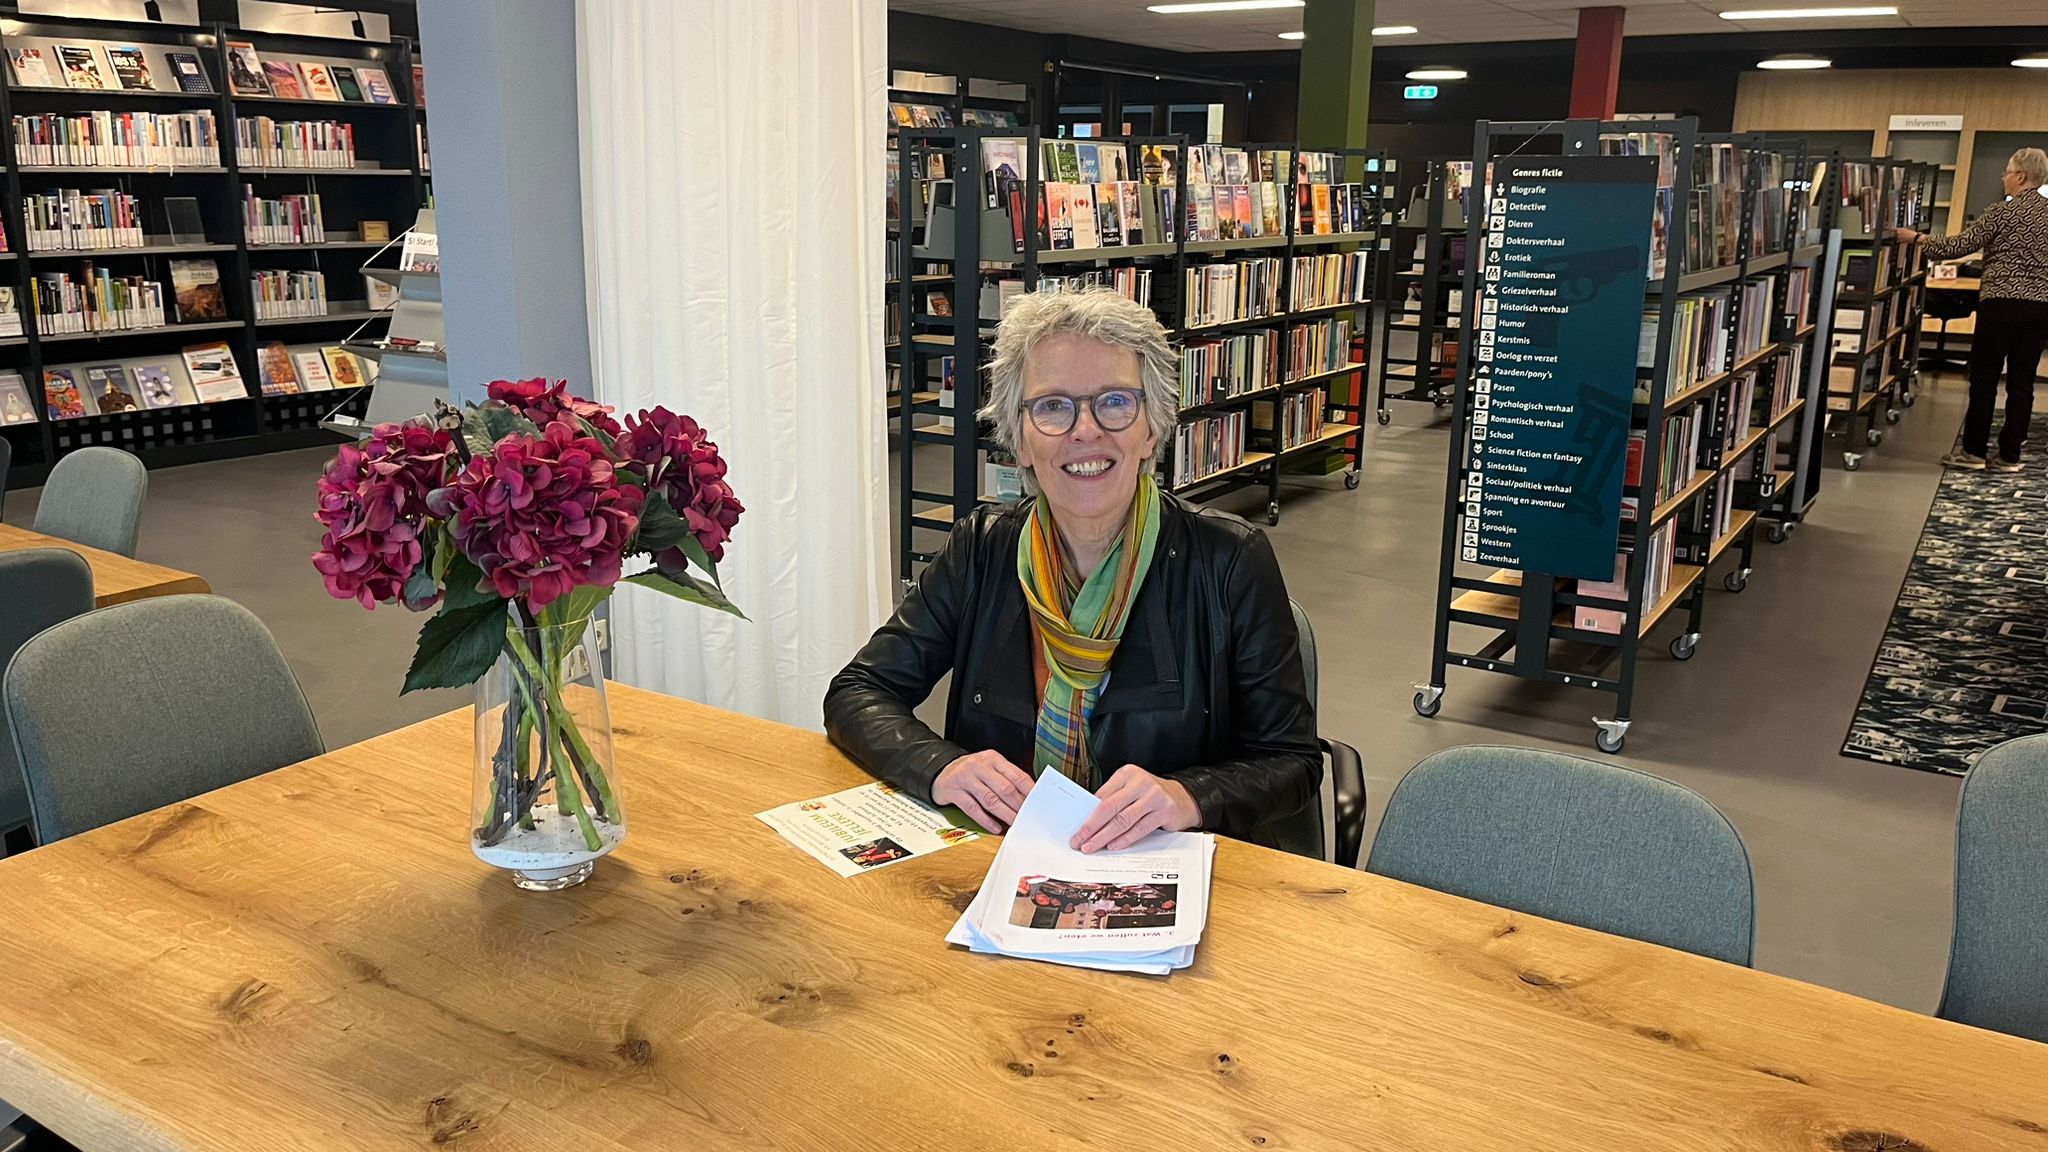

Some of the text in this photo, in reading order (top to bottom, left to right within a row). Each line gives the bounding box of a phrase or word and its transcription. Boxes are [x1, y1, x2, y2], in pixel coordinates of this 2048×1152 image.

[1511, 186, 1546, 196] Biografie
[1510, 202, 1546, 210] Detective
[1508, 220, 1533, 228] Dieren
[1506, 237, 1564, 246] Doktersverhaal
[1505, 254, 1532, 262] Erotiek
[1504, 270, 1556, 280] Familieroman
[1502, 287, 1556, 296] Griezelverhaal
[1500, 304, 1568, 314] Historisch verhaal
[1499, 320, 1526, 328] Humor
[1784, 316, 1796, 329] T
[1498, 336, 1530, 344] Kerstmis
[1496, 352, 1522, 362] Oorlog
[1494, 368, 1552, 380] Paarden/pony's
[1217, 378, 1226, 391] L
[1494, 384, 1514, 392] Pasen
[1492, 399, 1574, 412] Psychologisch verhaal
[1491, 415, 1564, 428] Romantisch verhaal
[1490, 430, 1514, 440] School
[1488, 446, 1582, 464] Science fiction en fantasy
[1486, 462, 1527, 472] Sinterklaas
[1486, 477, 1572, 494] Sociaal/politiek verhaal
[1484, 492, 1518, 504] Spanning
[1530, 500, 1566, 508] avontuur
[1483, 508, 1502, 516] Sport
[1482, 522, 1516, 534] Sprookjes
[1481, 538, 1511, 548] Western
[1479, 553, 1519, 565] Zeeverhaal
[808, 813, 862, 843] JUBILEUM
[828, 812, 872, 837] JELLEKE
